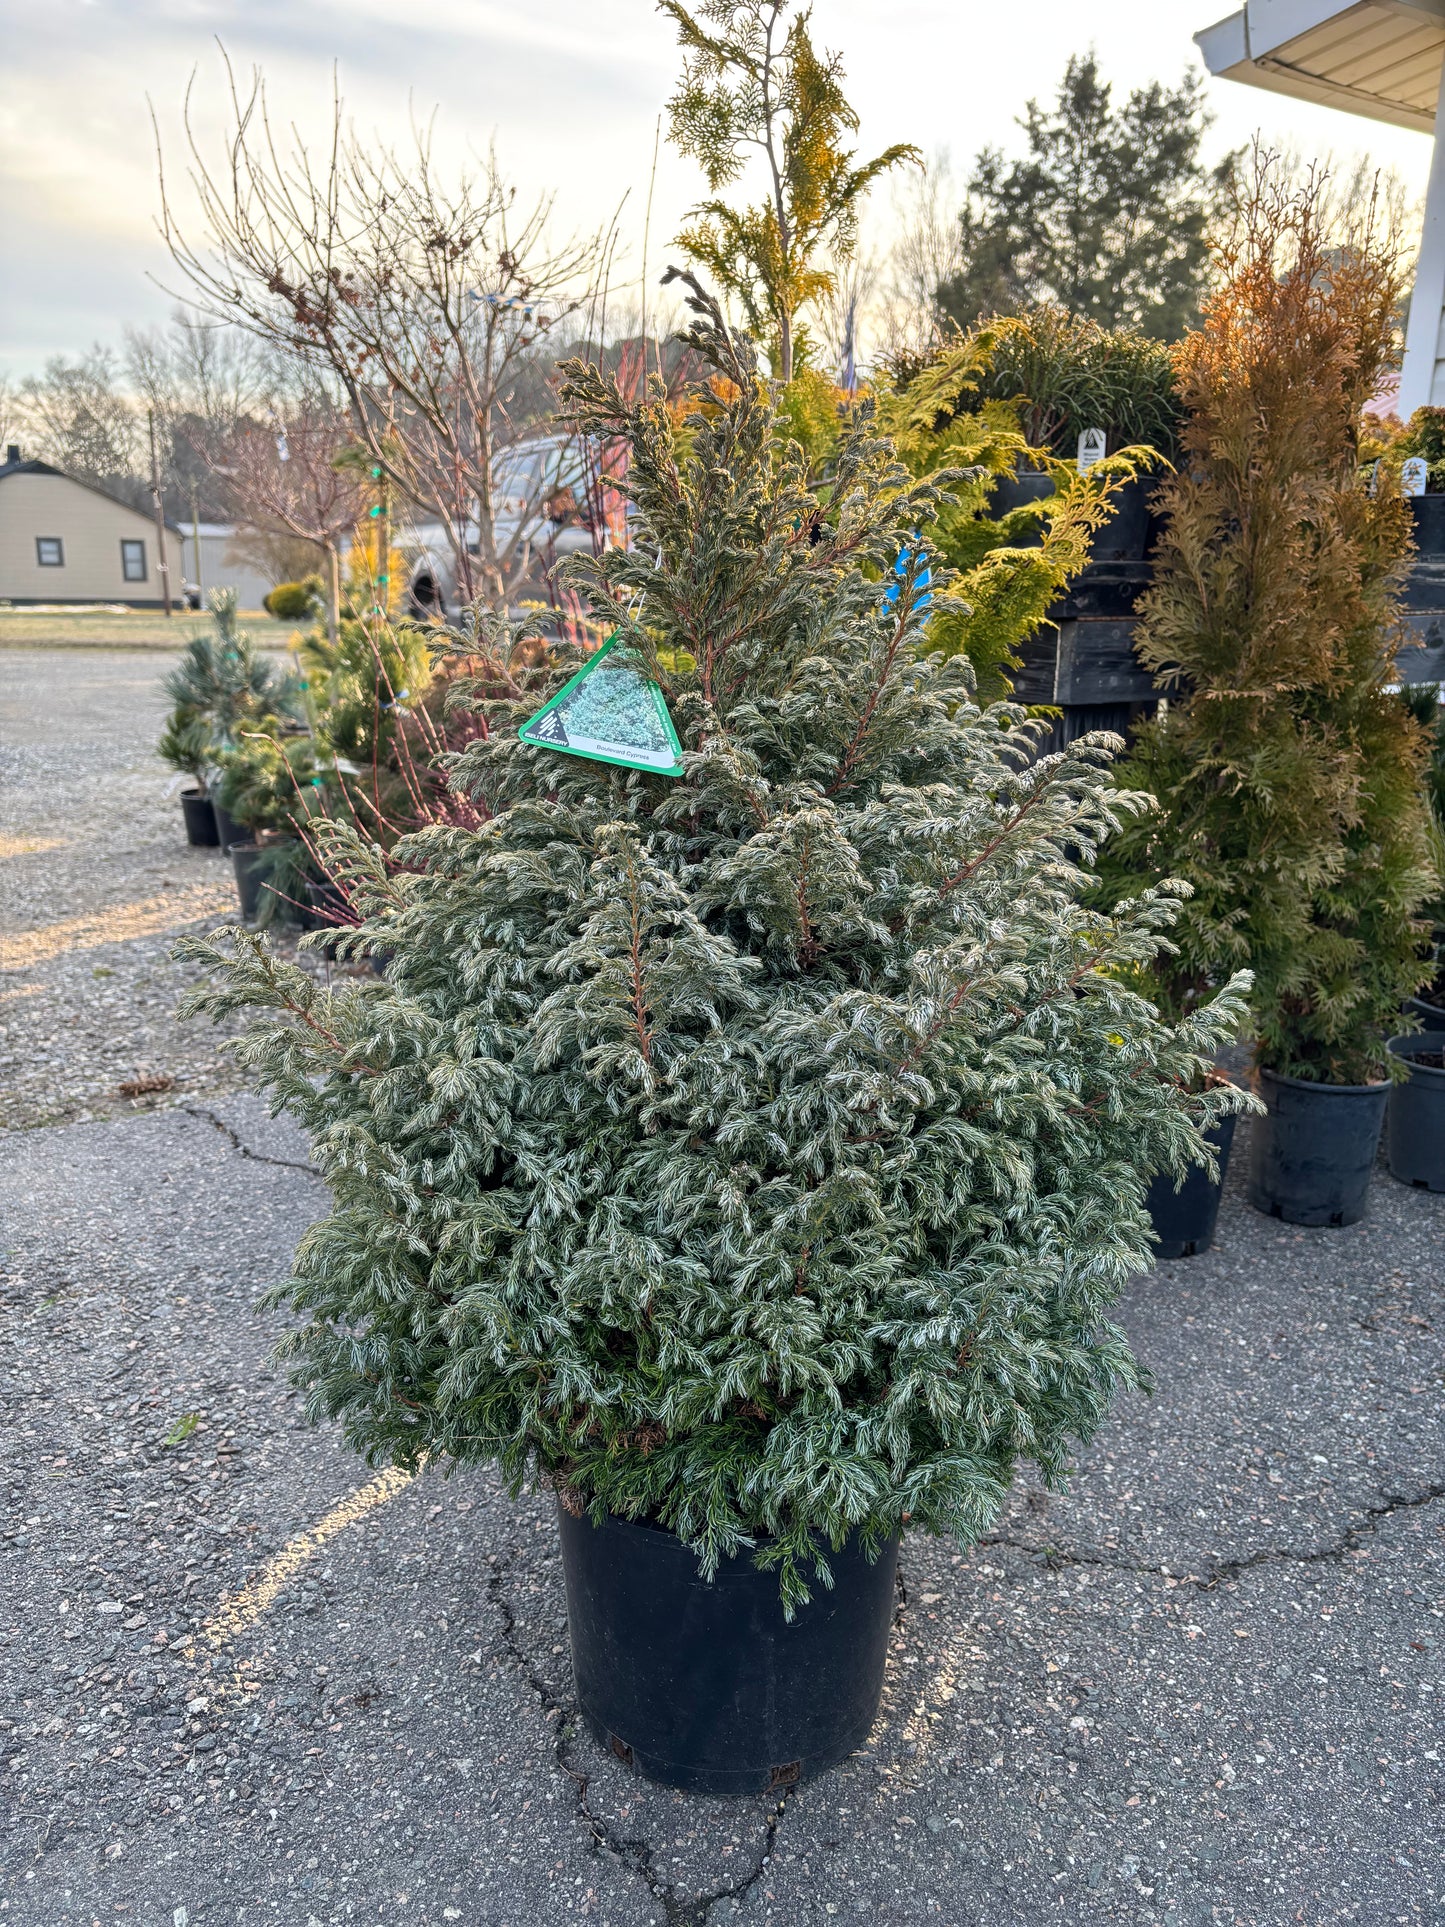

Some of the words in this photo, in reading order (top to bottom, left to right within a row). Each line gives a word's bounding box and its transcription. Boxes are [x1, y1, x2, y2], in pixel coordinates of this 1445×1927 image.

[524, 732, 539, 740] ISELI
[540, 736, 568, 746] NURSERY
[596, 744, 625, 755] Boulevard
[627, 751, 649, 760] Cypress
